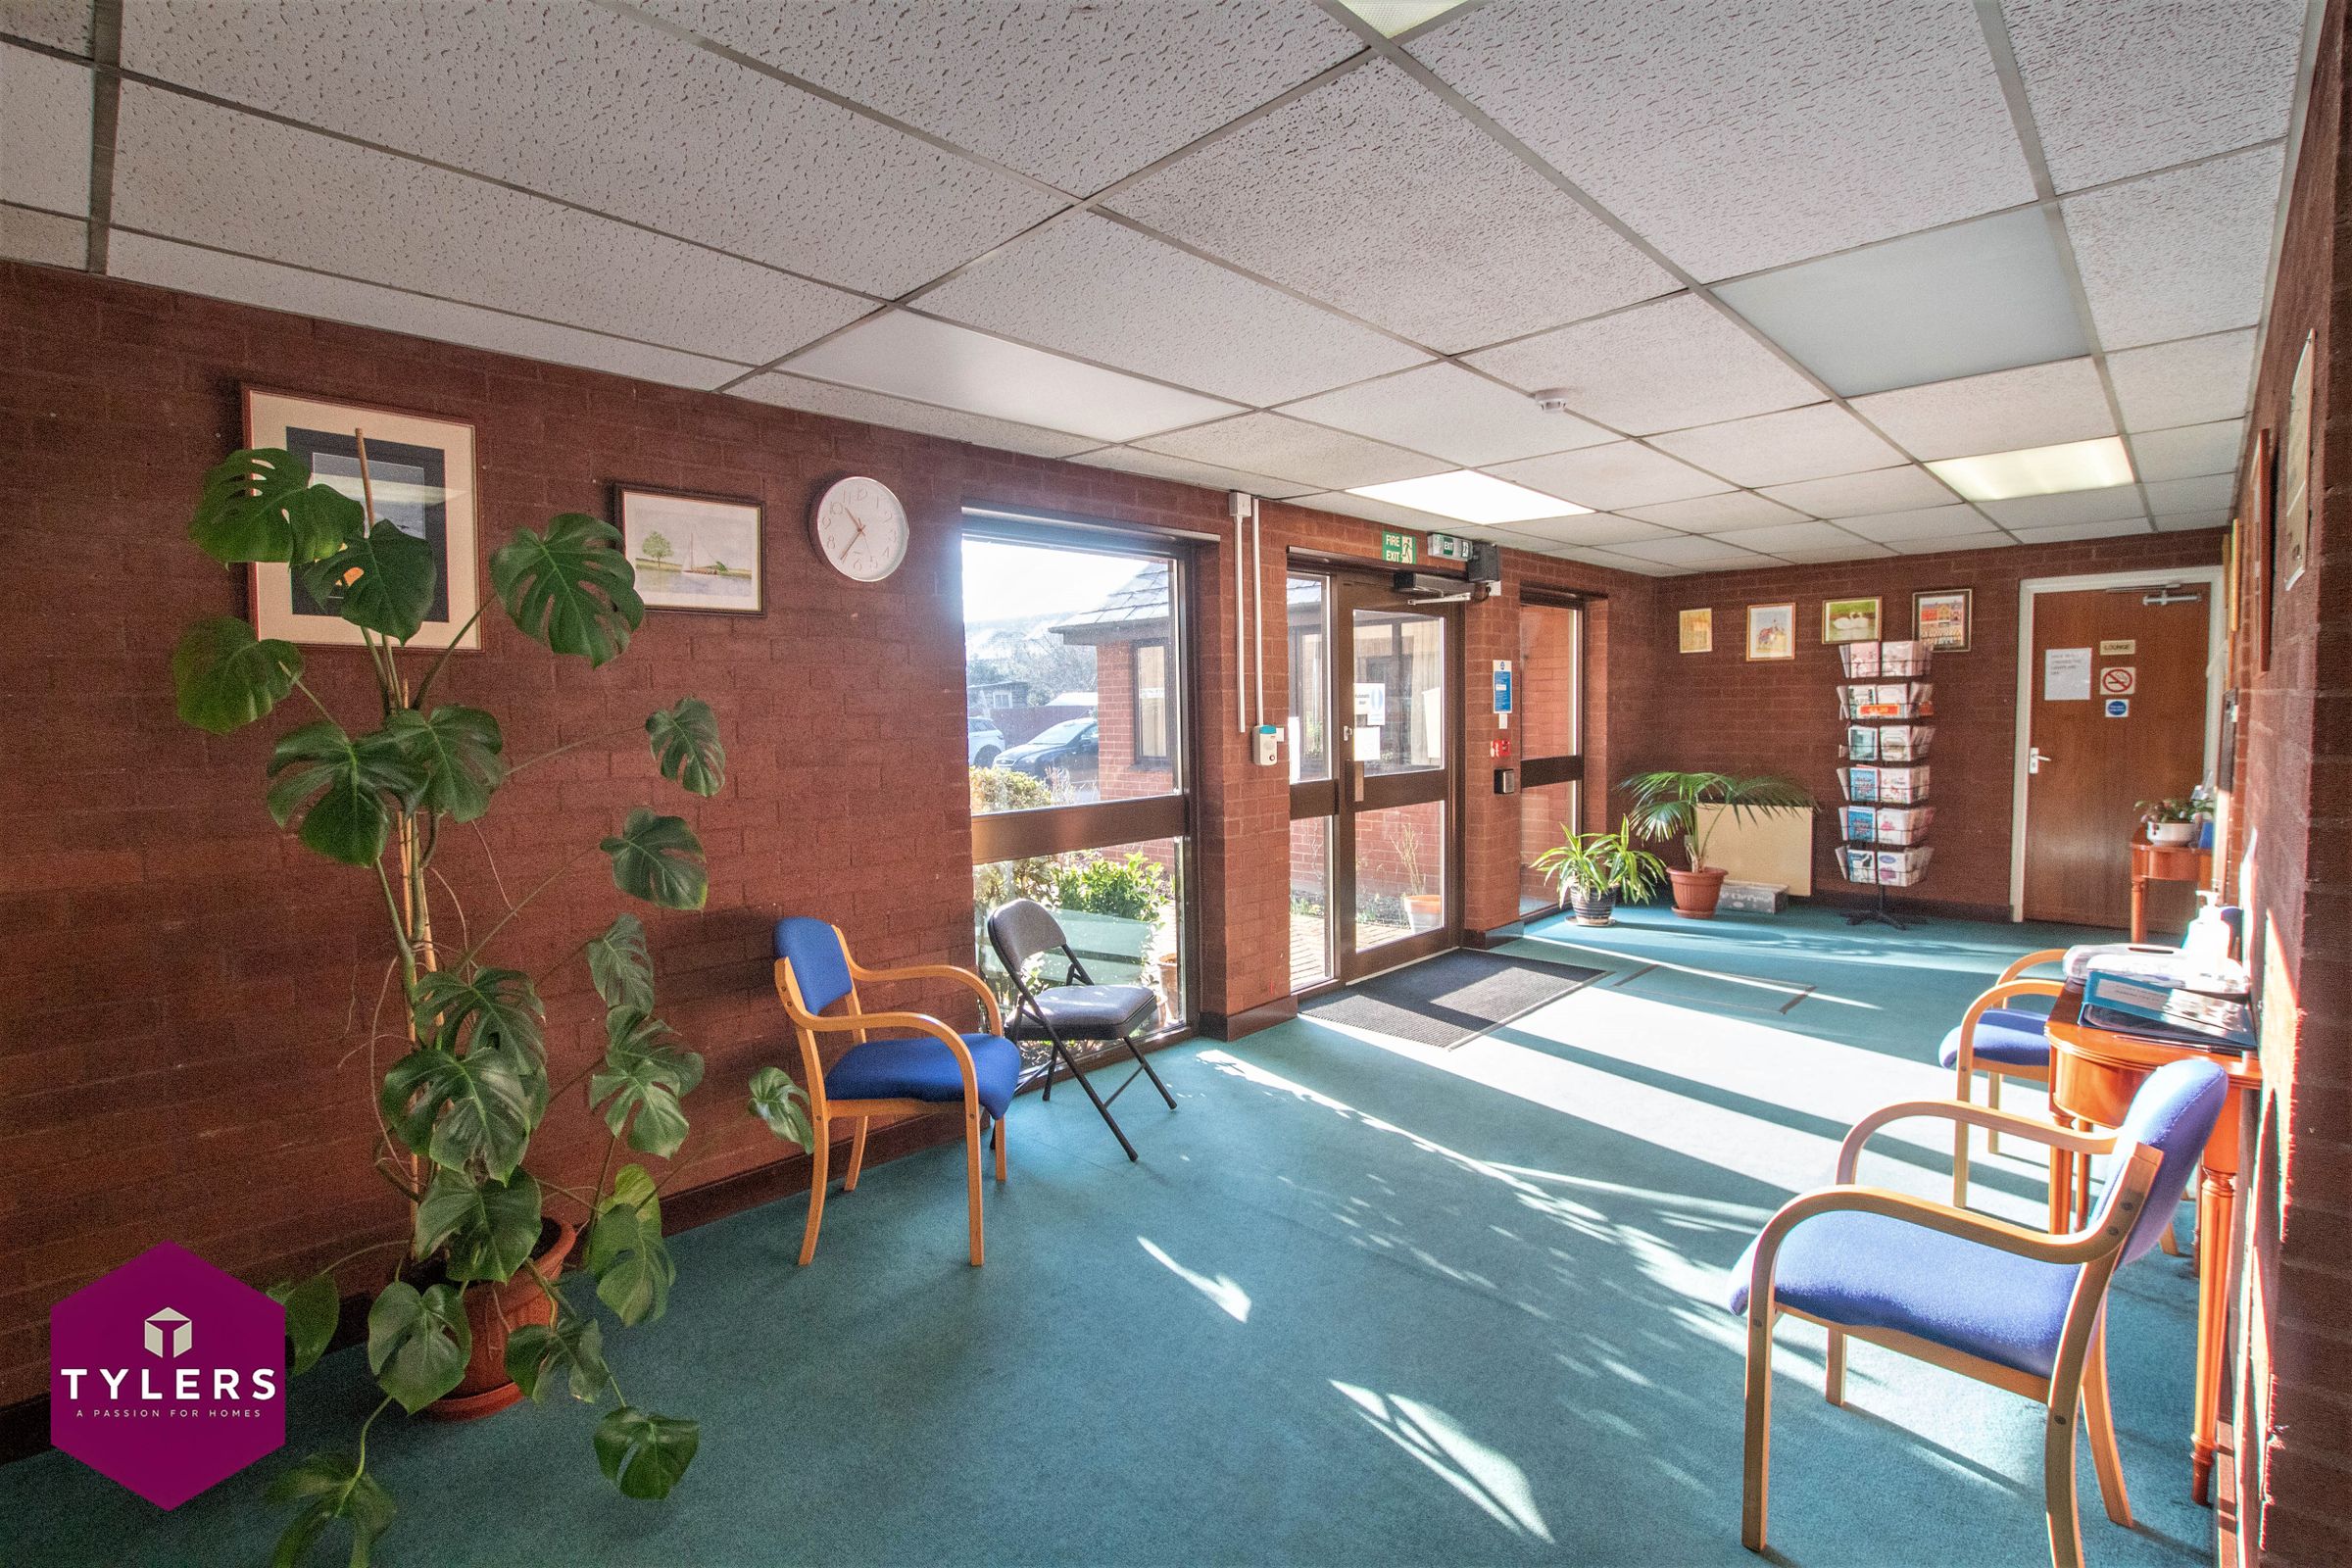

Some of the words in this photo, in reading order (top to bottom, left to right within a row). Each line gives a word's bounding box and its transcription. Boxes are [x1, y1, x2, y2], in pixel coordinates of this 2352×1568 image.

[827, 535, 836, 550] 8
[1386, 533, 1400, 547] FIRE
[1444, 541, 1453, 551] EXIT
[1386, 550, 1400, 563] EXIT
